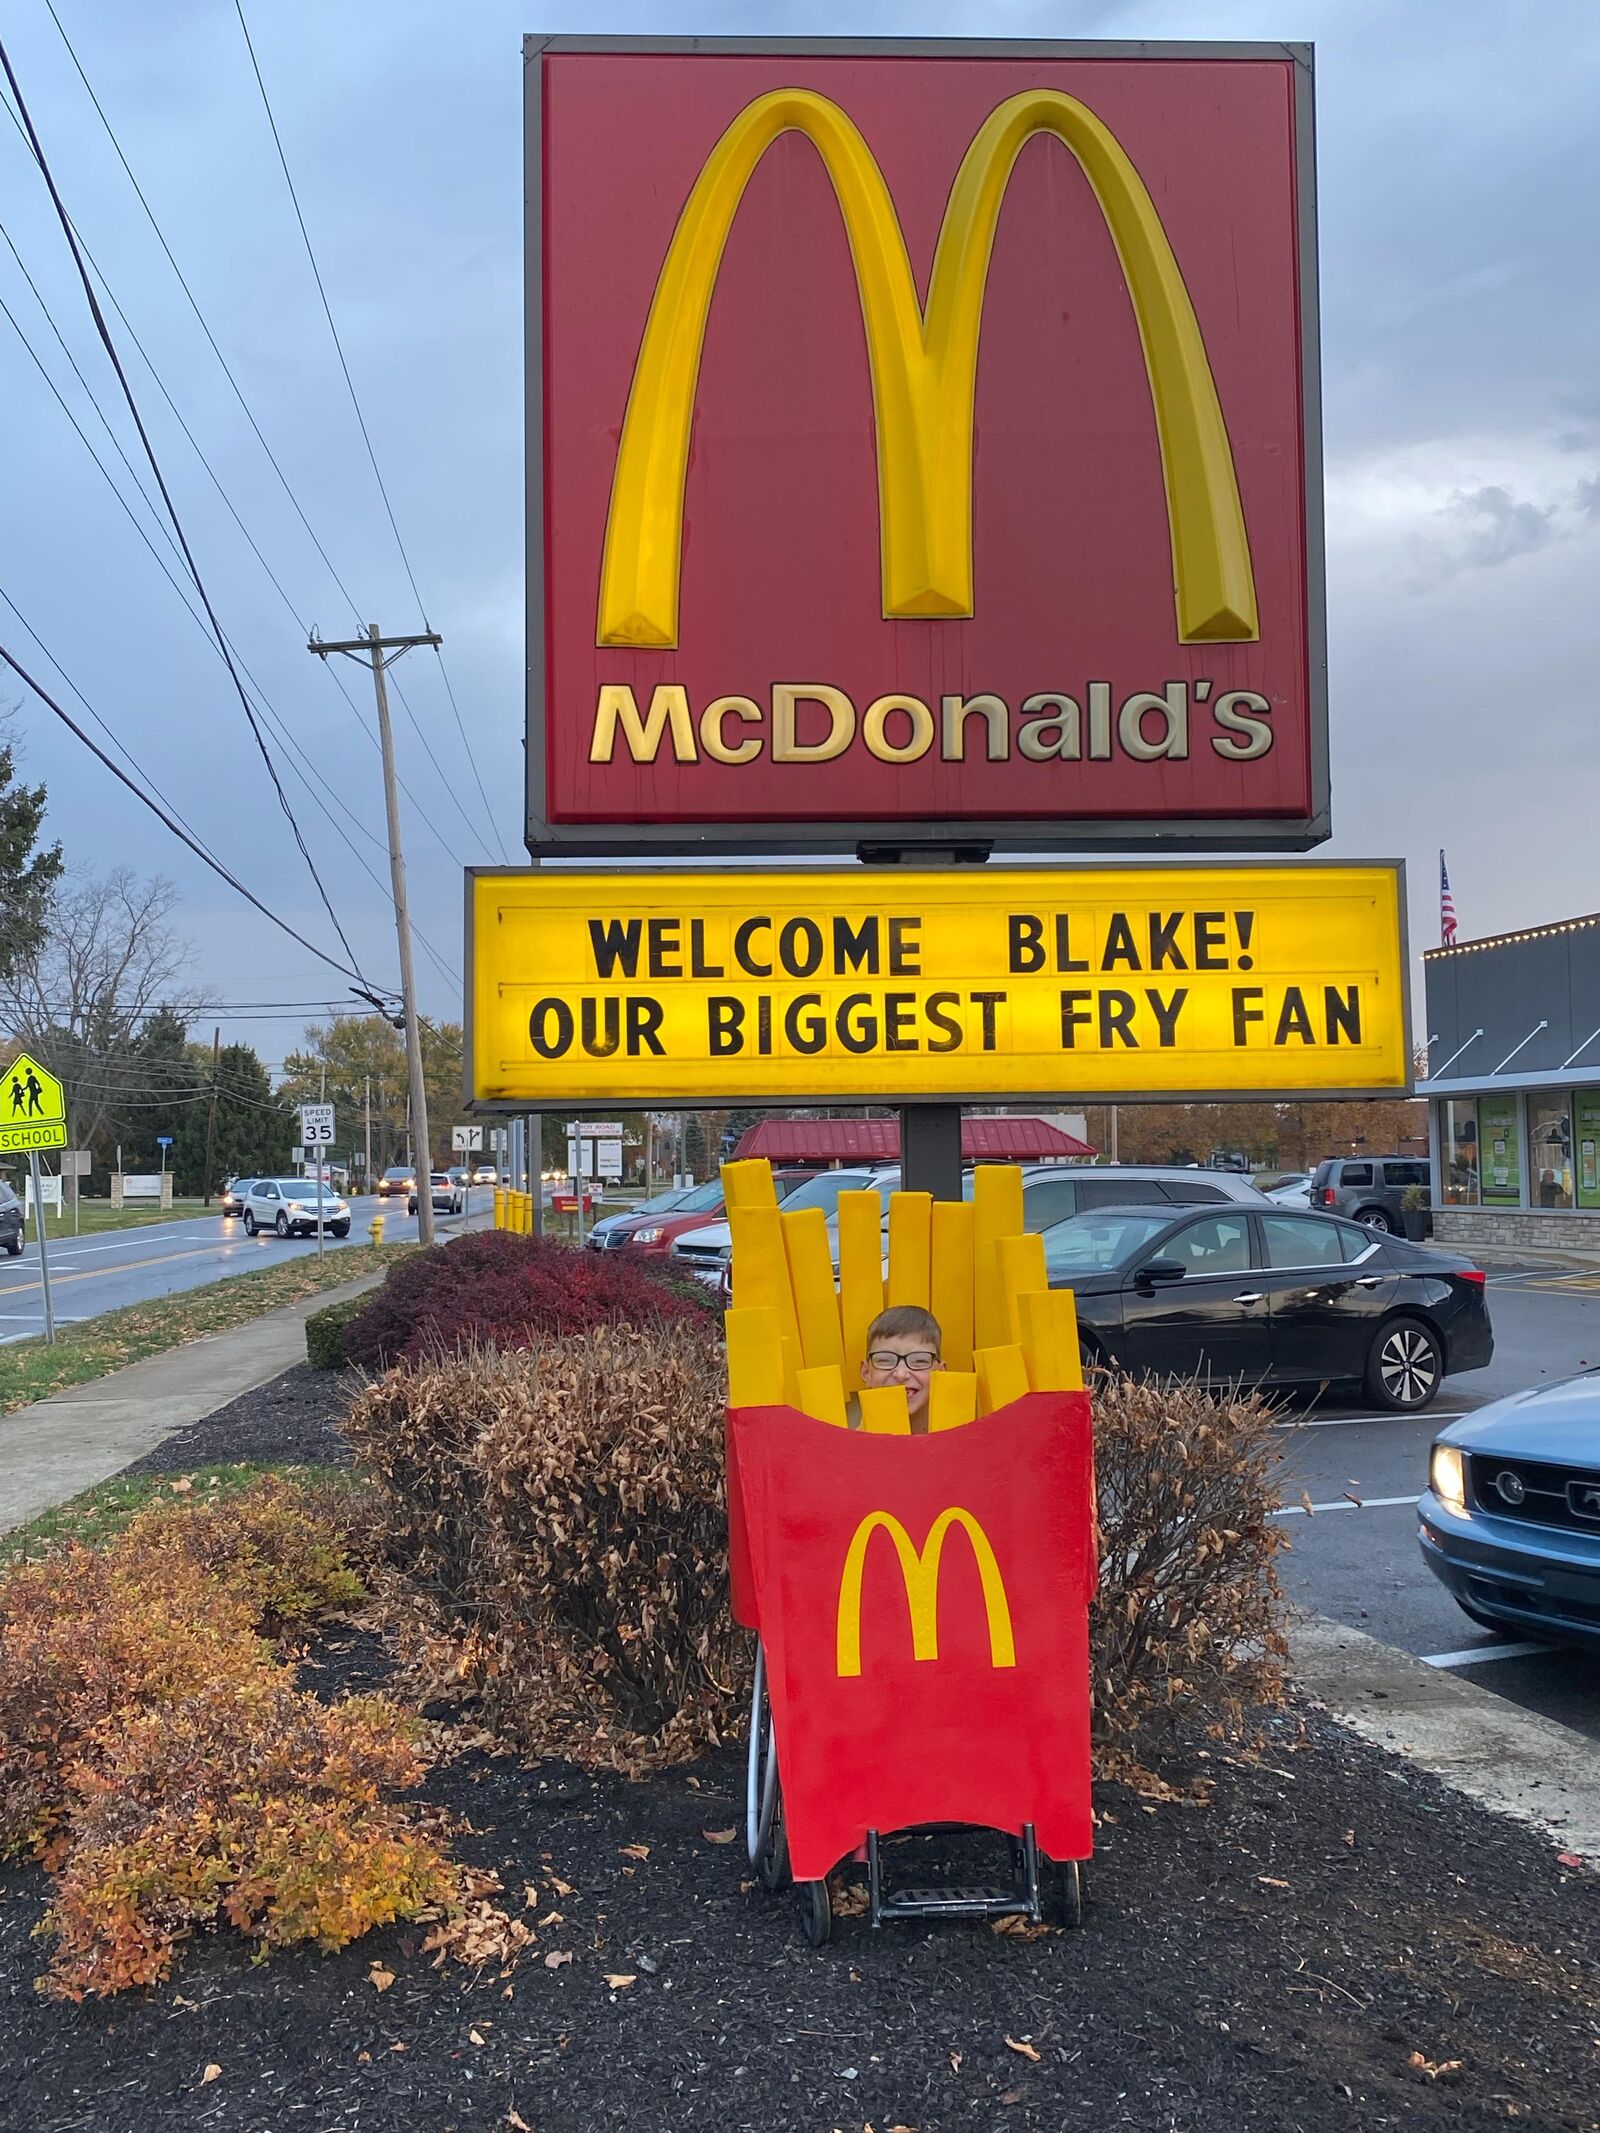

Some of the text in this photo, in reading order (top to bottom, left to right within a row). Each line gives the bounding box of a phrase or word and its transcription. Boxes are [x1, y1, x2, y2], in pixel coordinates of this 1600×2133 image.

[588, 679, 1273, 764] McDonald's
[588, 911, 1254, 978] WELCOME BLAKE!
[530, 985, 1361, 1059] OUR BIGGEST FRY FAN
[1, 1129, 61, 1147] SCHOOL
[305, 1125, 332, 1140] 35
